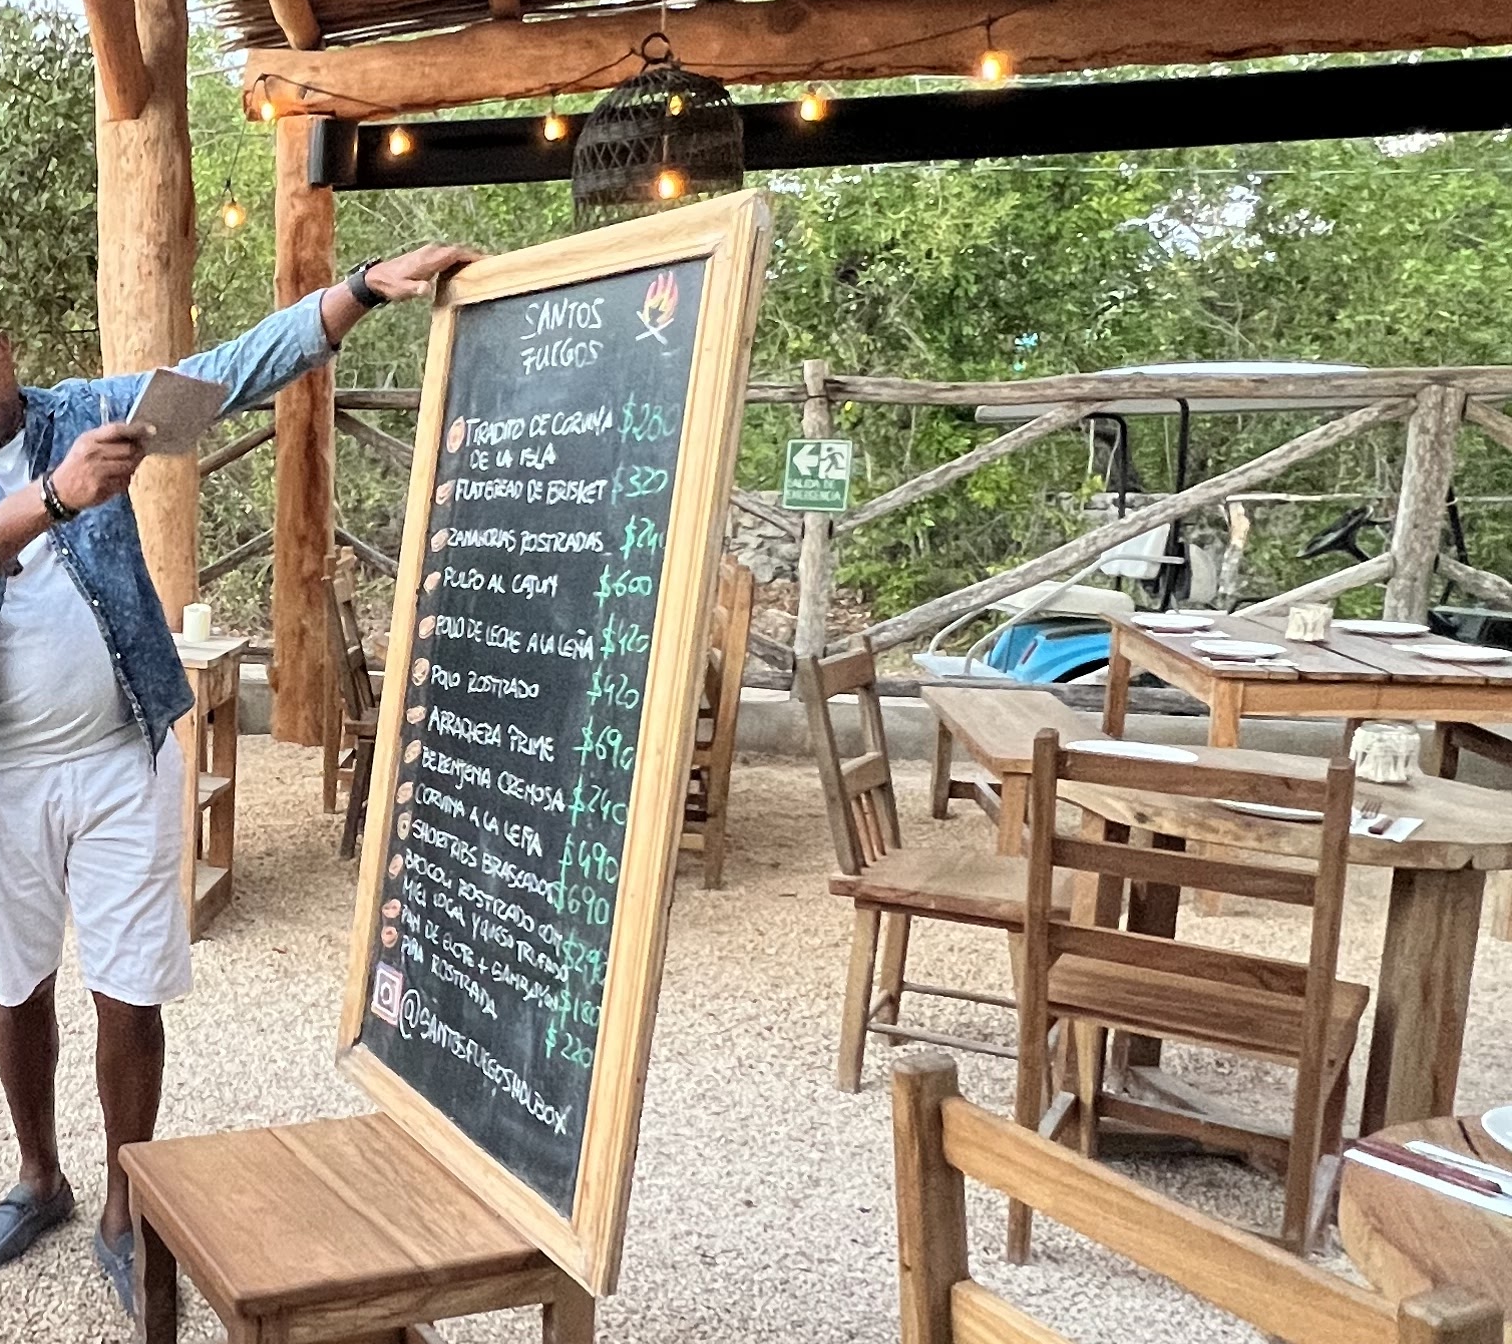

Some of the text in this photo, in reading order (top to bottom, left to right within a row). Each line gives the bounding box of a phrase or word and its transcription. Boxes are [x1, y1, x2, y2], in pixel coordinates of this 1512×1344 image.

[520, 297, 605, 340] SANTOS
[520, 338, 604, 375] FUEGOS
[465, 417, 525, 447] TIRADITO
[529, 413, 551, 438] DE
[469, 442, 557, 471] DE LA ISLA
[454, 477, 524, 502] FLATBREAD
[526, 479, 544, 504] DE
[545, 478, 608, 505] BRISKET
[443, 564, 653, 608] PULPO AL CAJUN $600
[435, 614, 465, 639] POLLO
[467, 618, 483, 643] DE
[485, 624, 521, 654] LECHE
[526, 632, 538, 653] A
[431, 664, 461, 691] POLLO
[427, 706, 501, 748] ARRACHERA
[507, 724, 555, 763] PRIME
[497, 770, 566, 812] CREMOSA
[469, 806, 480, 827] A
[482, 810, 499, 836] LA
[538, 922, 563, 957] CON
[545, 1017, 594, 1068] $220
